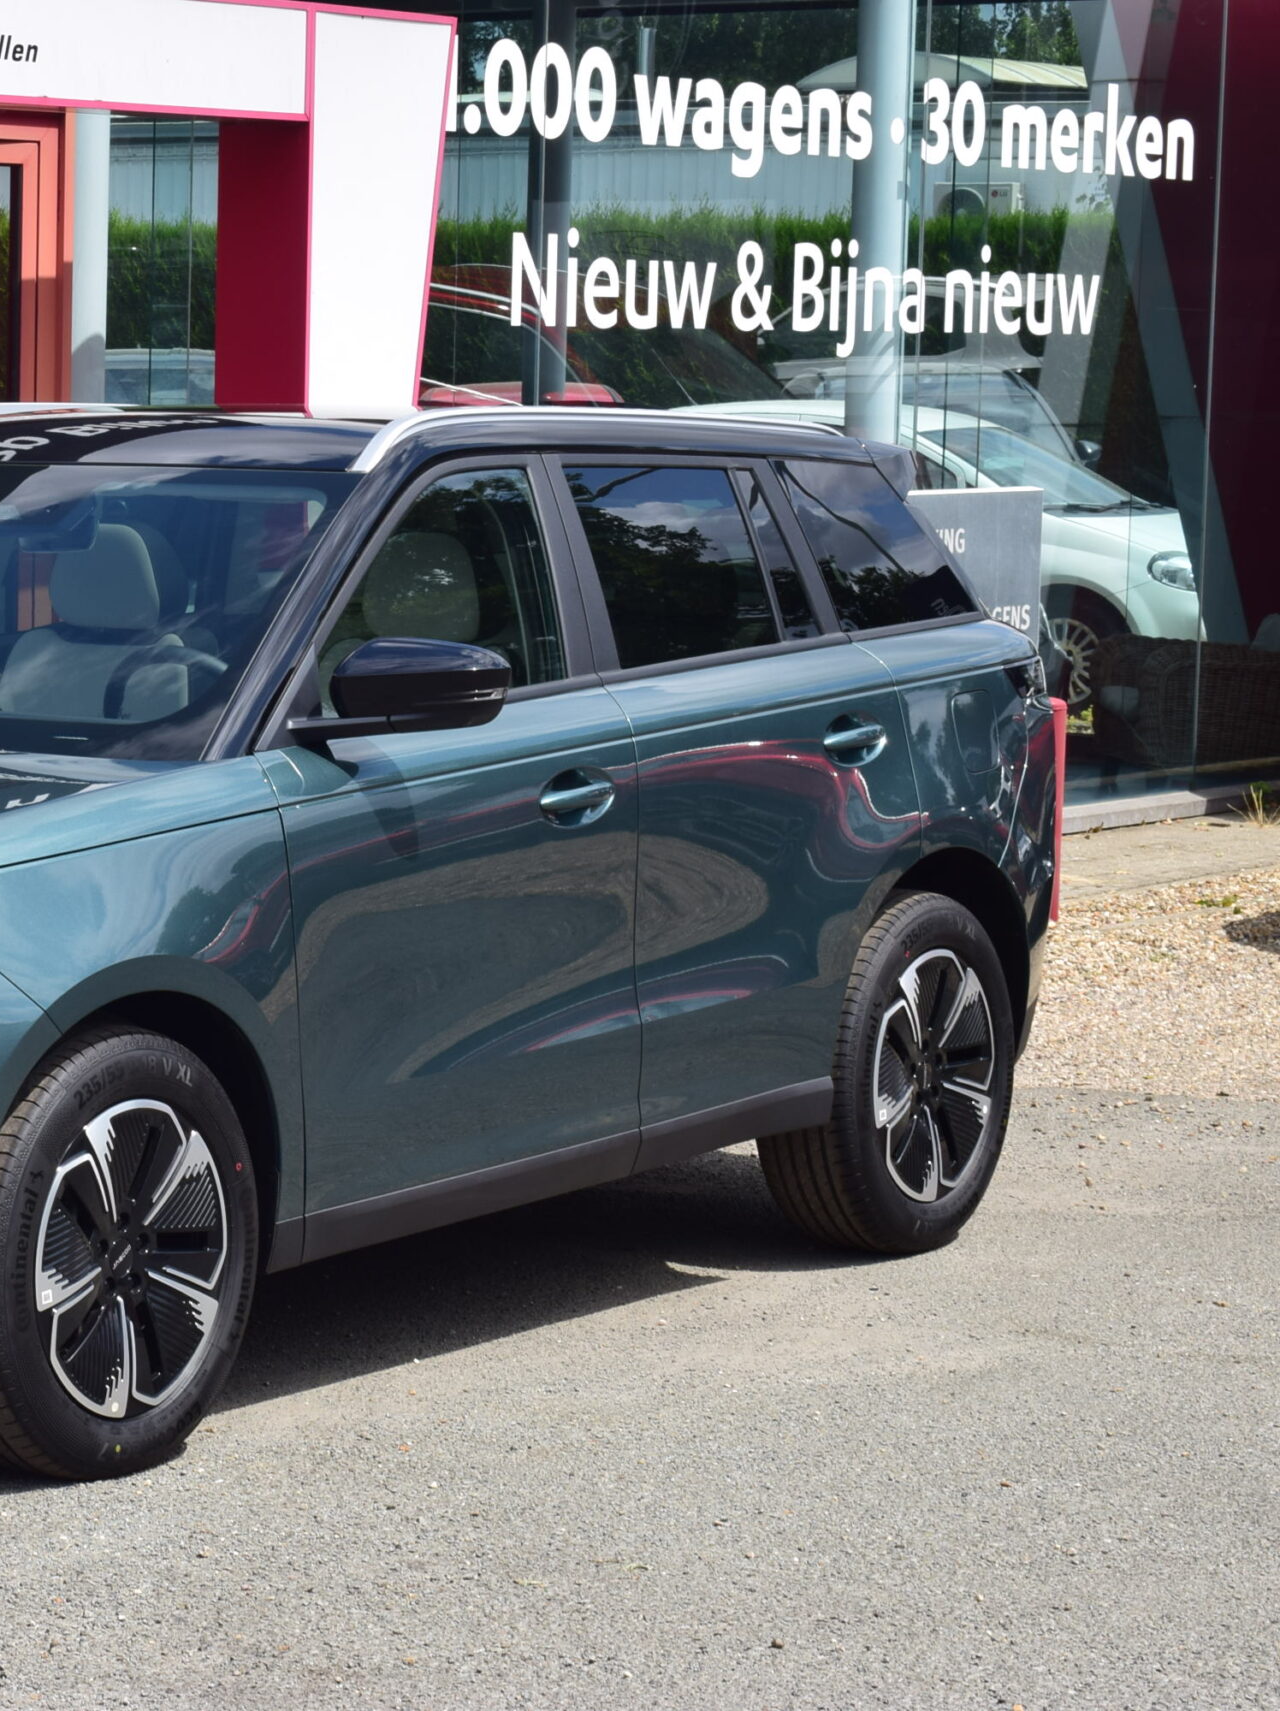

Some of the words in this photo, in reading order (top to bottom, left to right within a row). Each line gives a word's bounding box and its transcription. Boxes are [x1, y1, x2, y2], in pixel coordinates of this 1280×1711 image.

[634, 74, 873, 178] wagens
[920, 78, 986, 167] 30
[1001, 83, 1195, 181] merken
[509, 227, 717, 330] Nieuw
[730, 241, 774, 332] &
[791, 238, 926, 358] Bijna
[943, 245, 1100, 335] nieuw
